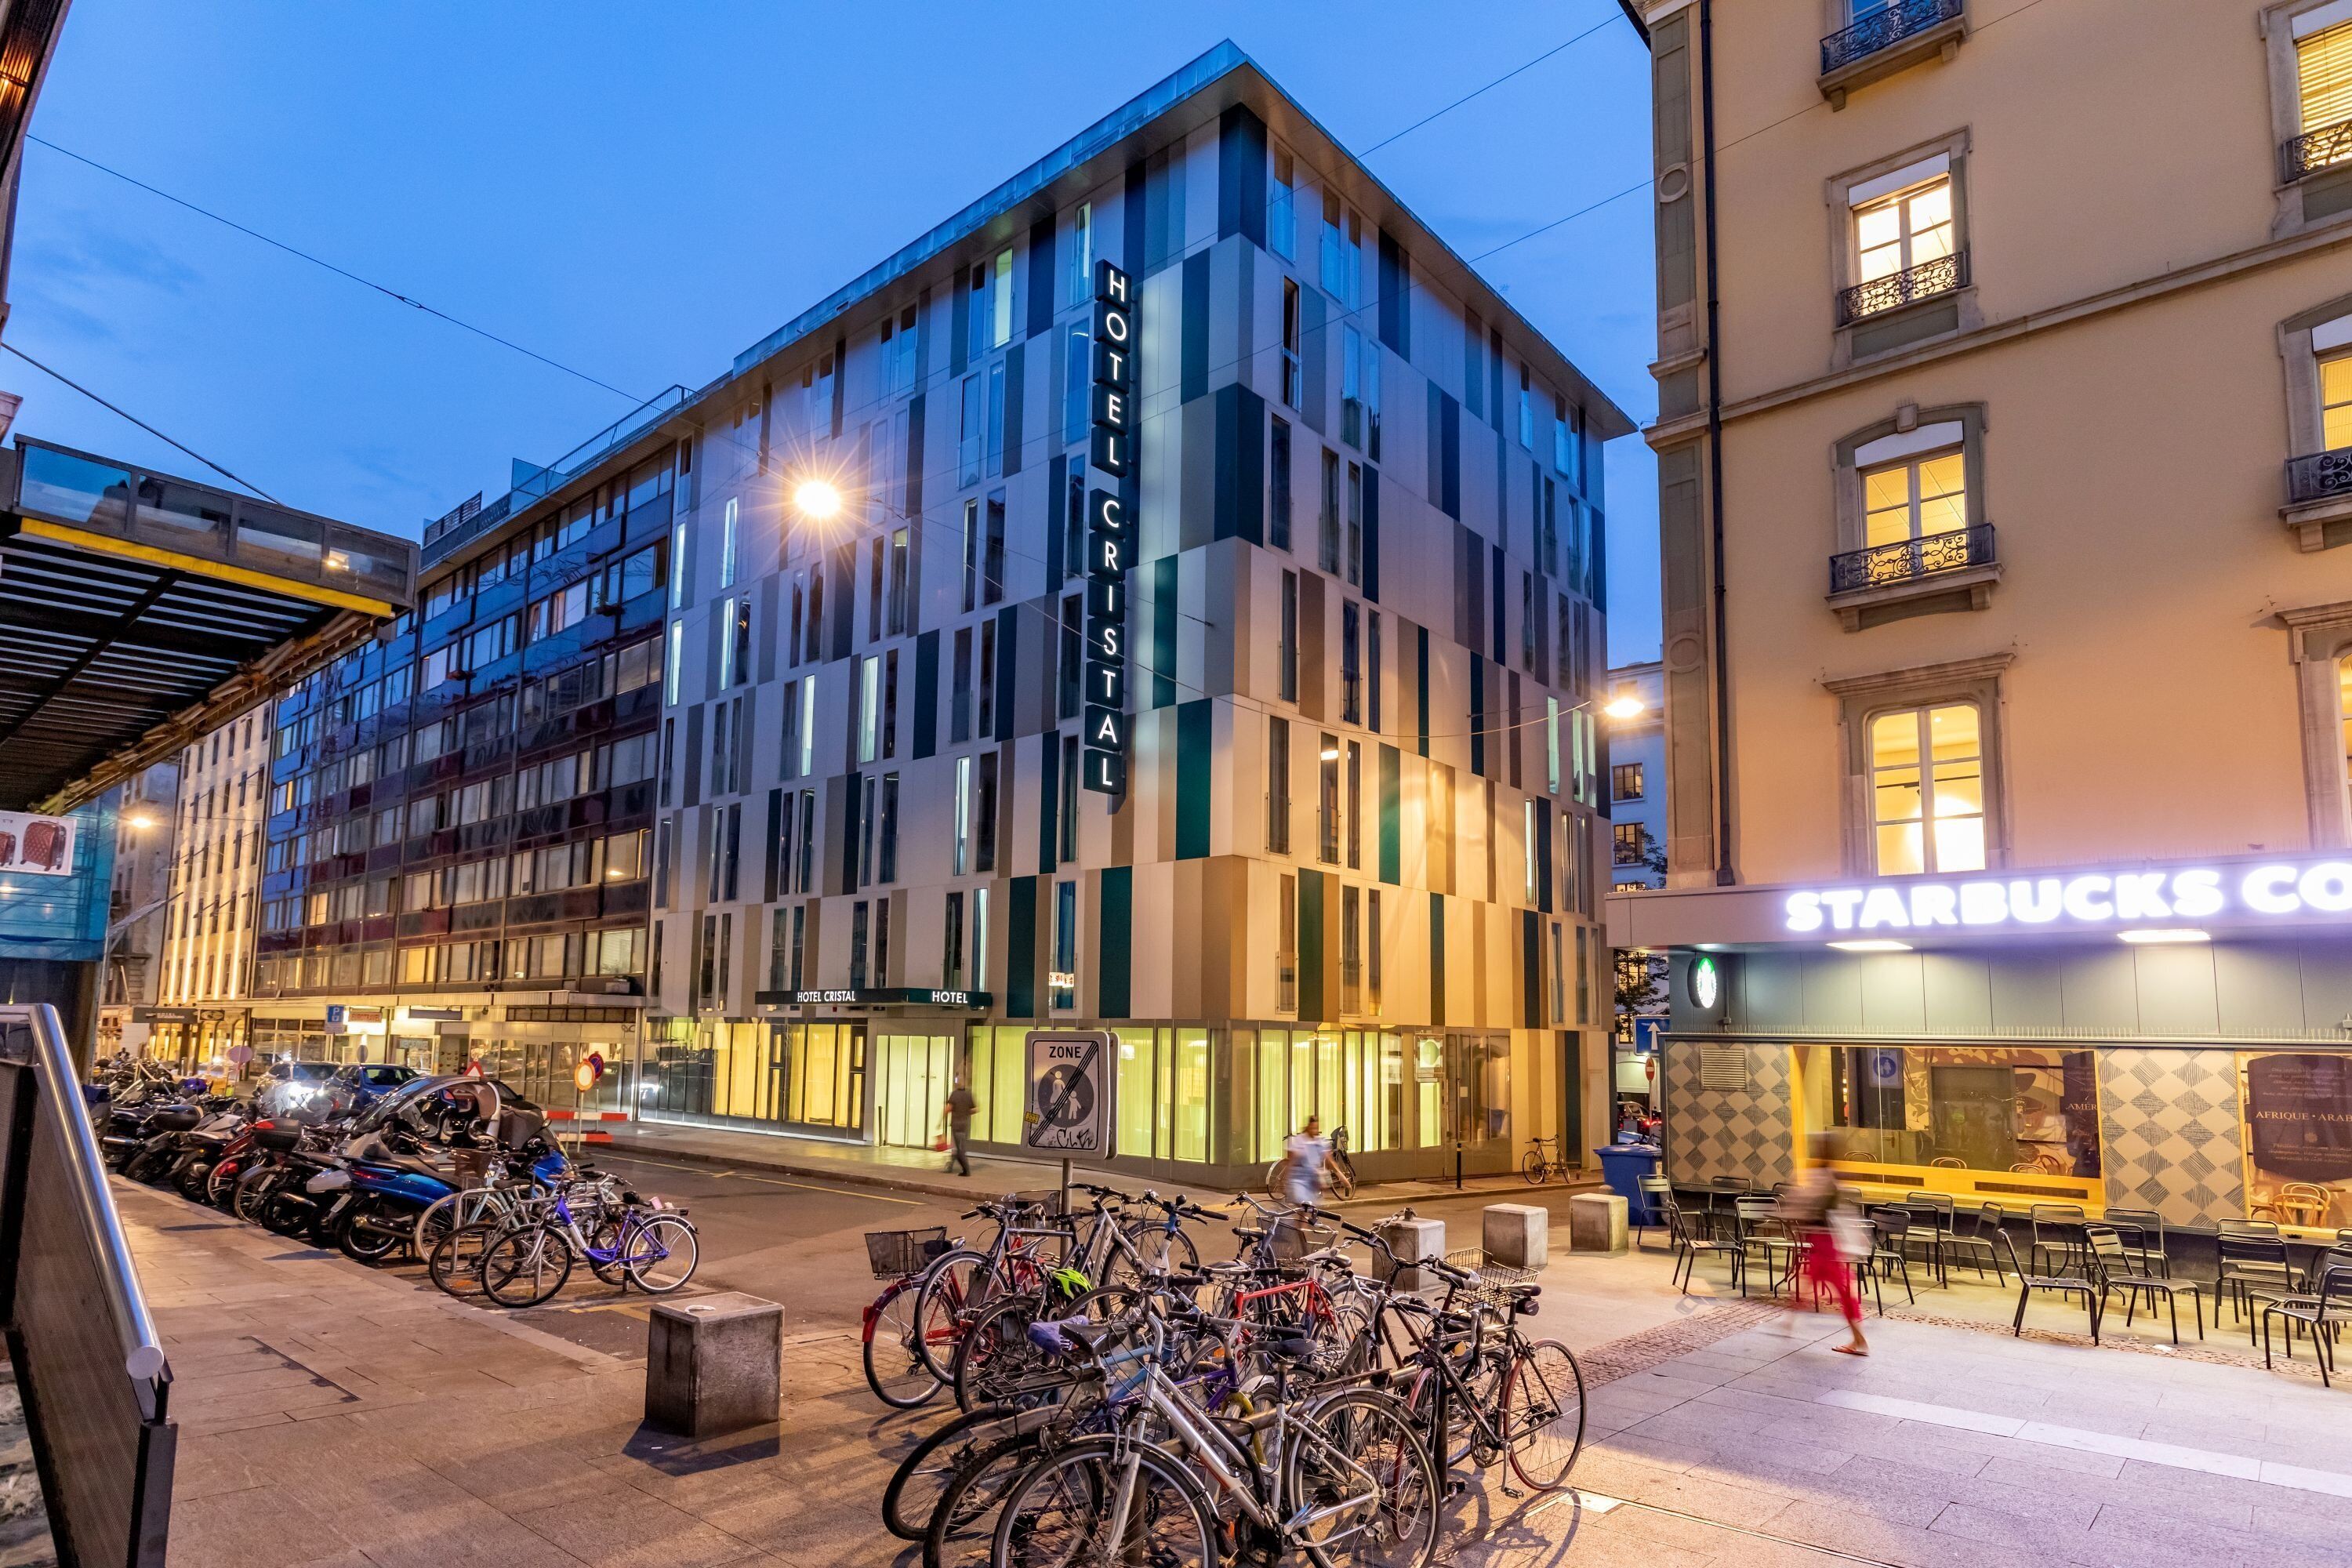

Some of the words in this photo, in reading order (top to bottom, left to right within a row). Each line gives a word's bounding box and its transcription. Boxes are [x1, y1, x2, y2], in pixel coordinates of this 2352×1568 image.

[1106, 268, 1127, 467] HOTEL
[1098, 499, 1120, 787] CRISTAL
[1785, 869, 2224, 931] STARBUCKS
[2241, 862, 2352, 913] CO
[797, 992, 822, 1003] HOTEL
[823, 990, 856, 1002] CRISTAL
[932, 991, 968, 1004] HOTEL
[1049, 1046, 1082, 1058] ZONE
[2256, 1111, 2309, 1121] AFRIQUE
